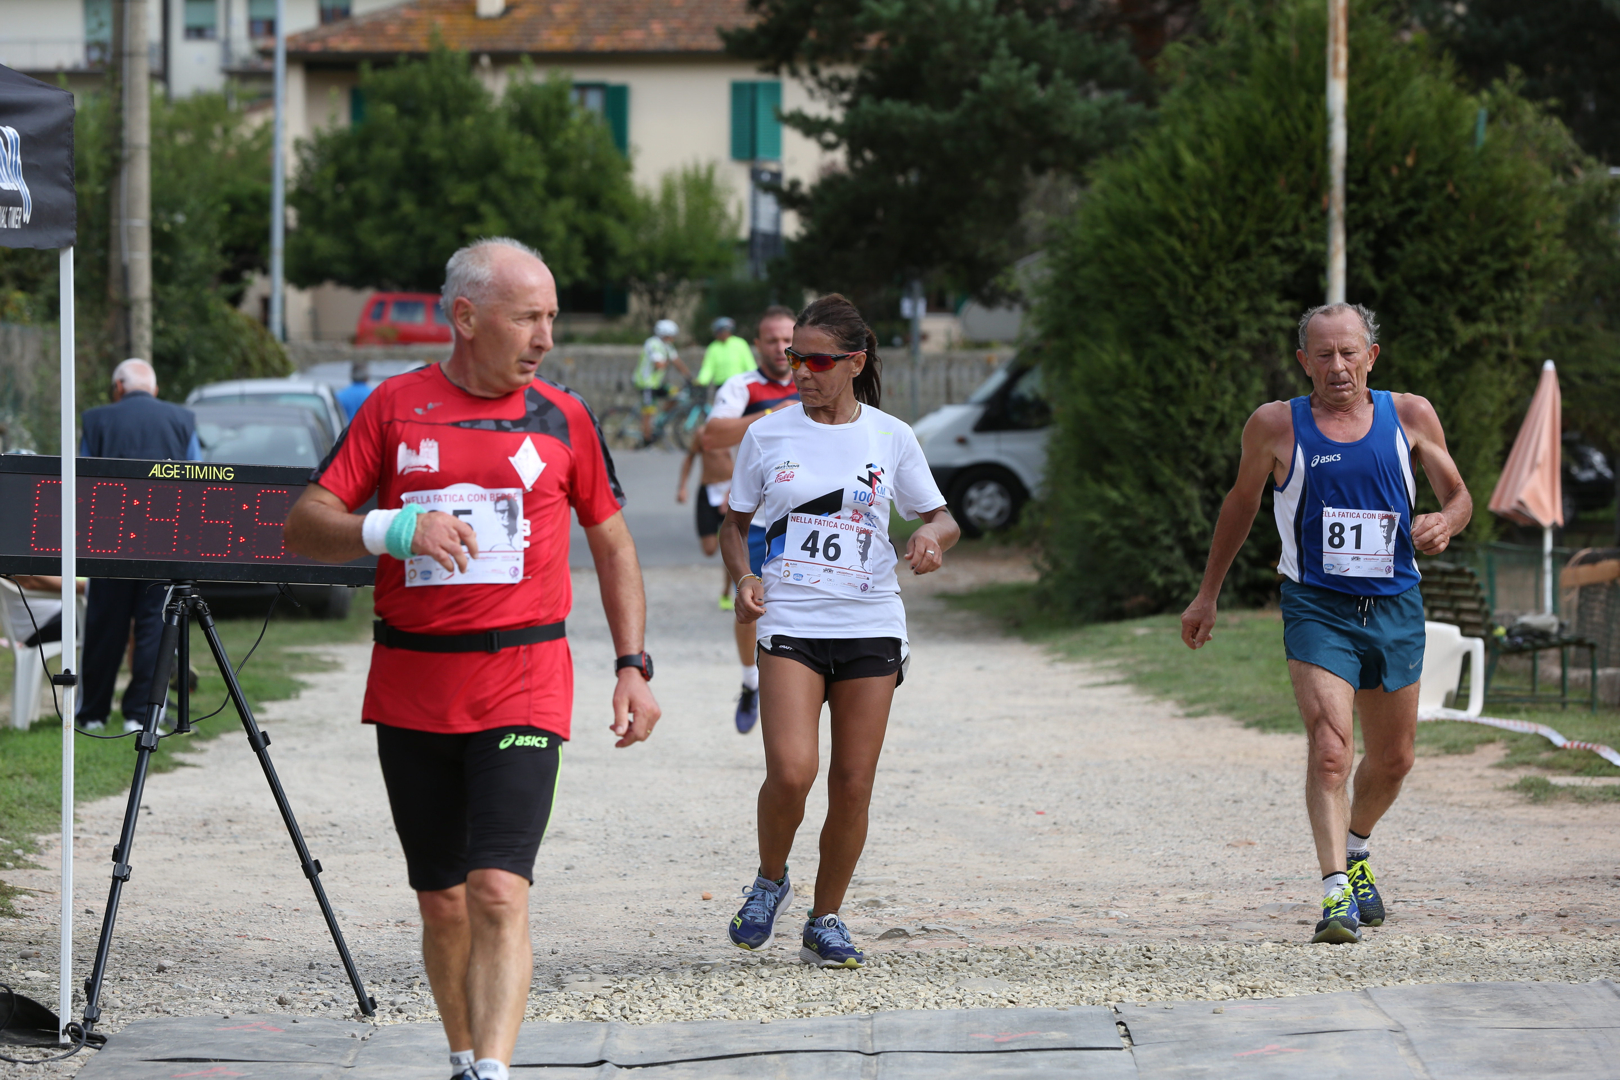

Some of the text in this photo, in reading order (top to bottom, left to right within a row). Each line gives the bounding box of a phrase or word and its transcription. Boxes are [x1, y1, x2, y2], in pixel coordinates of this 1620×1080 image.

[1319, 453, 1342, 464] asics
[147, 463, 235, 481] ALGE-TIMING
[405, 492, 519, 505] NELLA FATICA CON BEPPE
[1322, 510, 1398, 521] ELLA FATICA CON BEPPE
[790, 515, 813, 525] NELLA
[814, 518, 838, 529] FATICA
[839, 522, 855, 532] CON
[855, 526, 874, 537] BEPPE
[1327, 521, 1363, 550] 81
[800, 529, 842, 562] 46
[514, 734, 549, 749] asics
